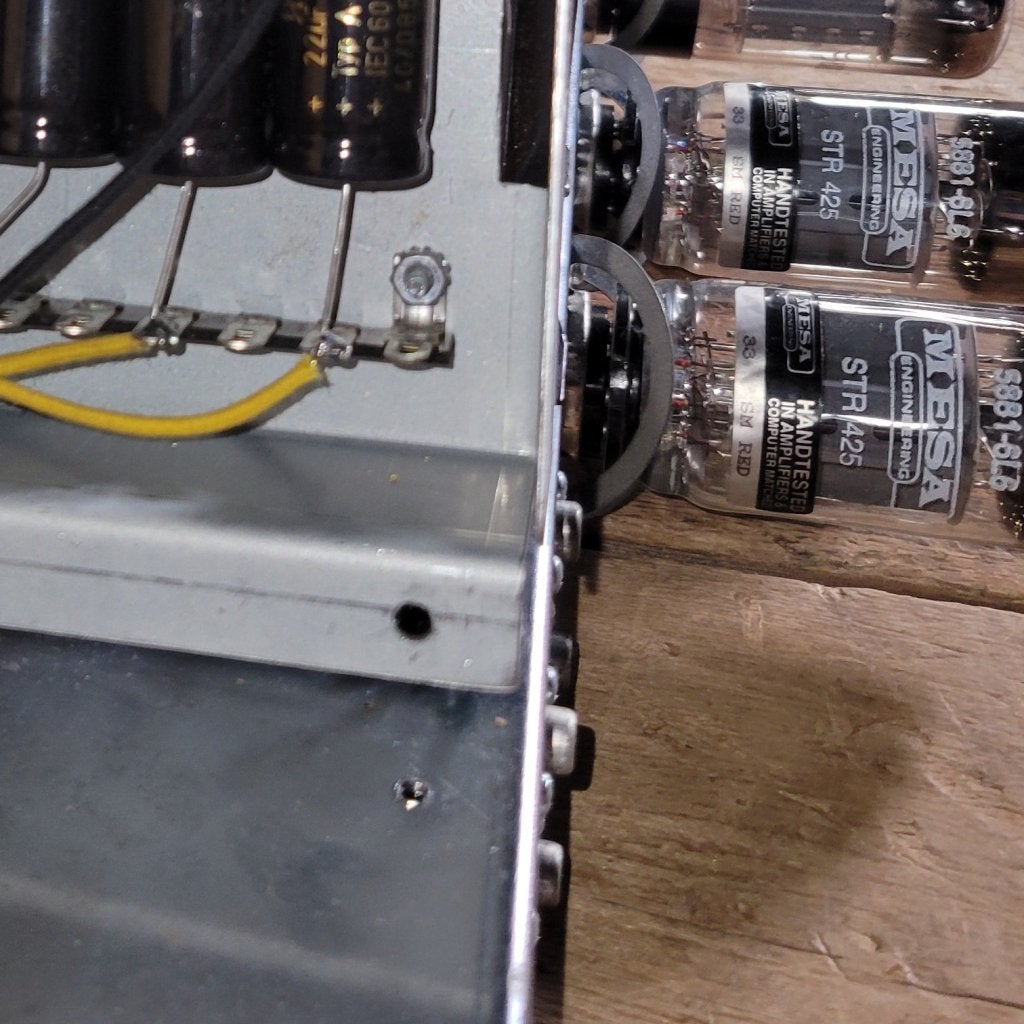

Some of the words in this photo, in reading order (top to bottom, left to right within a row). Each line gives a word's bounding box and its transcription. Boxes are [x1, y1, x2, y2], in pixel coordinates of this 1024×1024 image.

[365, 35, 390, 76] IEC
[732, 106, 745, 124] 33
[763, 169, 776, 184] IN
[820, 129, 844, 173] STR
[869, 128, 884, 231] ENGINEERING
[729, 193, 742, 225] RED
[749, 167, 763, 227] COMPUTER
[819, 182, 841, 221] 425
[886, 109, 918, 257] MESA
[770, 167, 793, 270] HANDTESTED
[742, 335, 756, 359] 33
[796, 297, 813, 364] MESA
[781, 401, 796, 419] IN
[841, 356, 868, 413] STR
[765, 398, 780, 467] COMPUTER
[839, 422, 864, 467] 425
[898, 355, 914, 480] ENGINEERING
[919, 328, 955, 508] MESA
[989, 368, 1023, 492] 5881-6L6
[737, 442, 753, 477] RED
[775, 422, 795, 501] AMPLIFIERS
[789, 399, 815, 513] HANDTESTED
